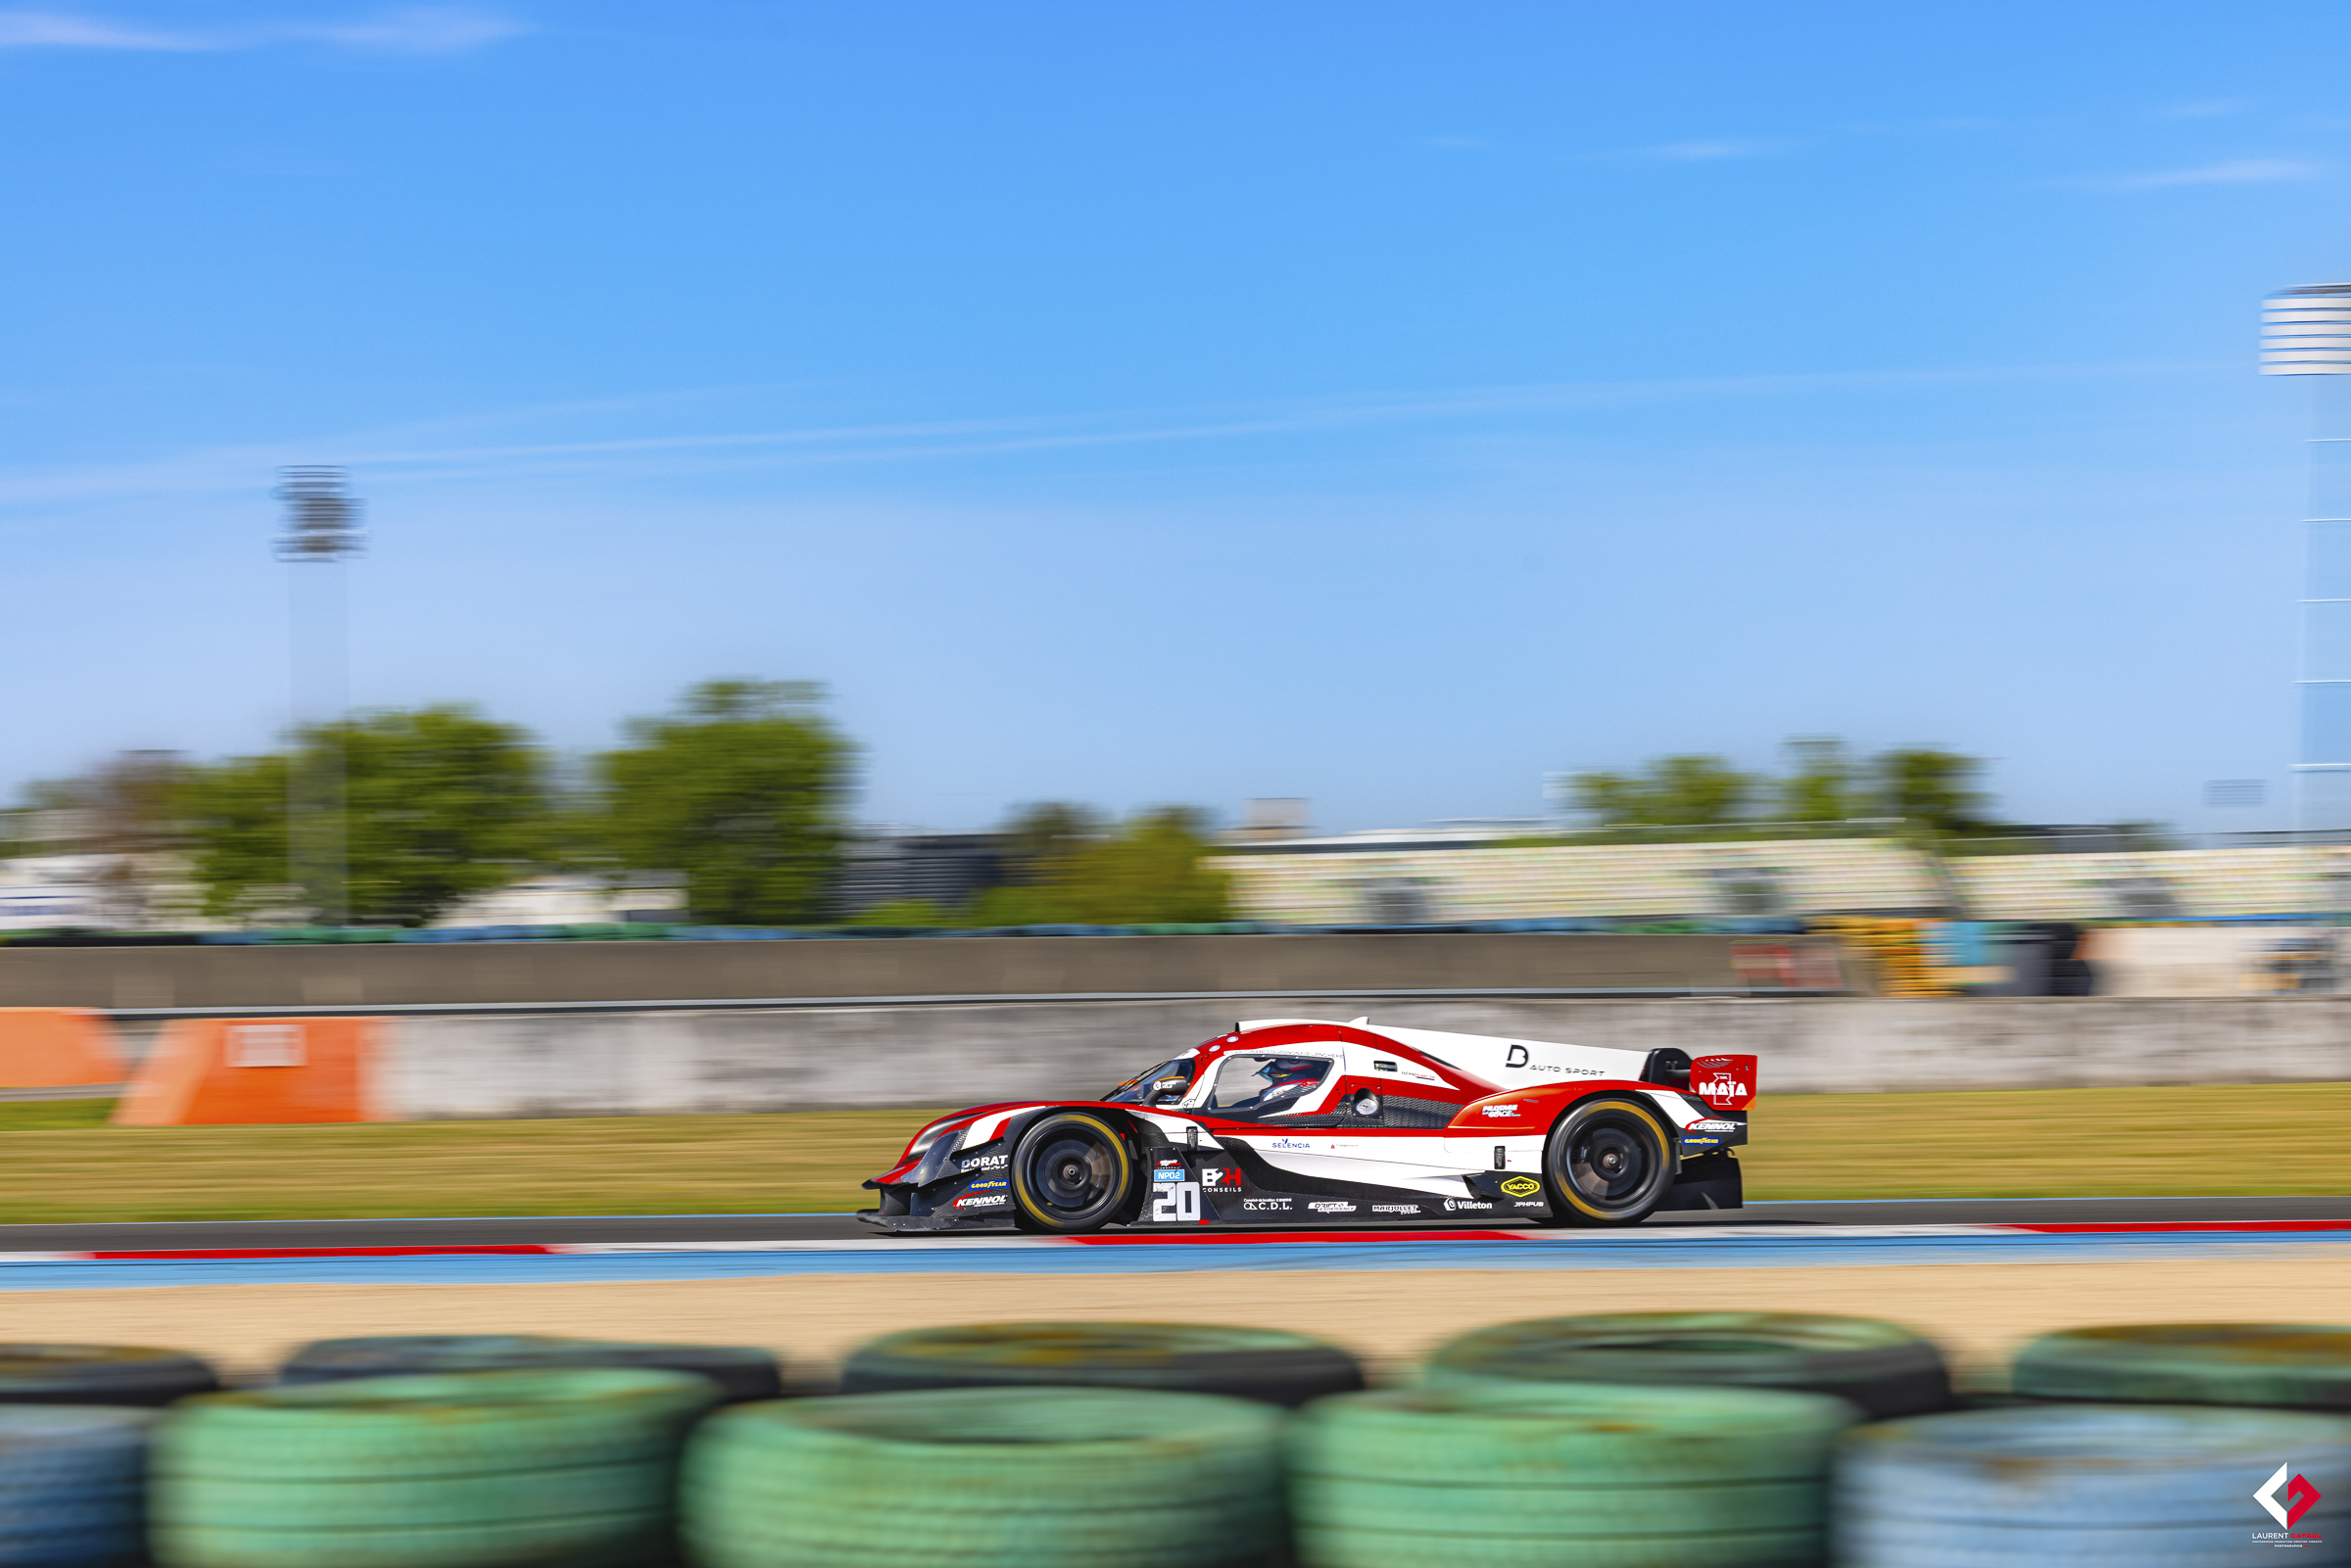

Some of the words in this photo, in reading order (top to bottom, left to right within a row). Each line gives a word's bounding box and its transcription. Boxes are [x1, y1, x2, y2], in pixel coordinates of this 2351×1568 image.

[1565, 1068, 1606, 1076] SPORT
[961, 1155, 1009, 1168] DORAT
[1202, 1167, 1241, 1186] B2H
[971, 1180, 1007, 1189] GOODYEAR
[956, 1194, 1007, 1207] KENNOL
[1153, 1181, 1201, 1221] 20
[1457, 1200, 1493, 1210] Villeton
